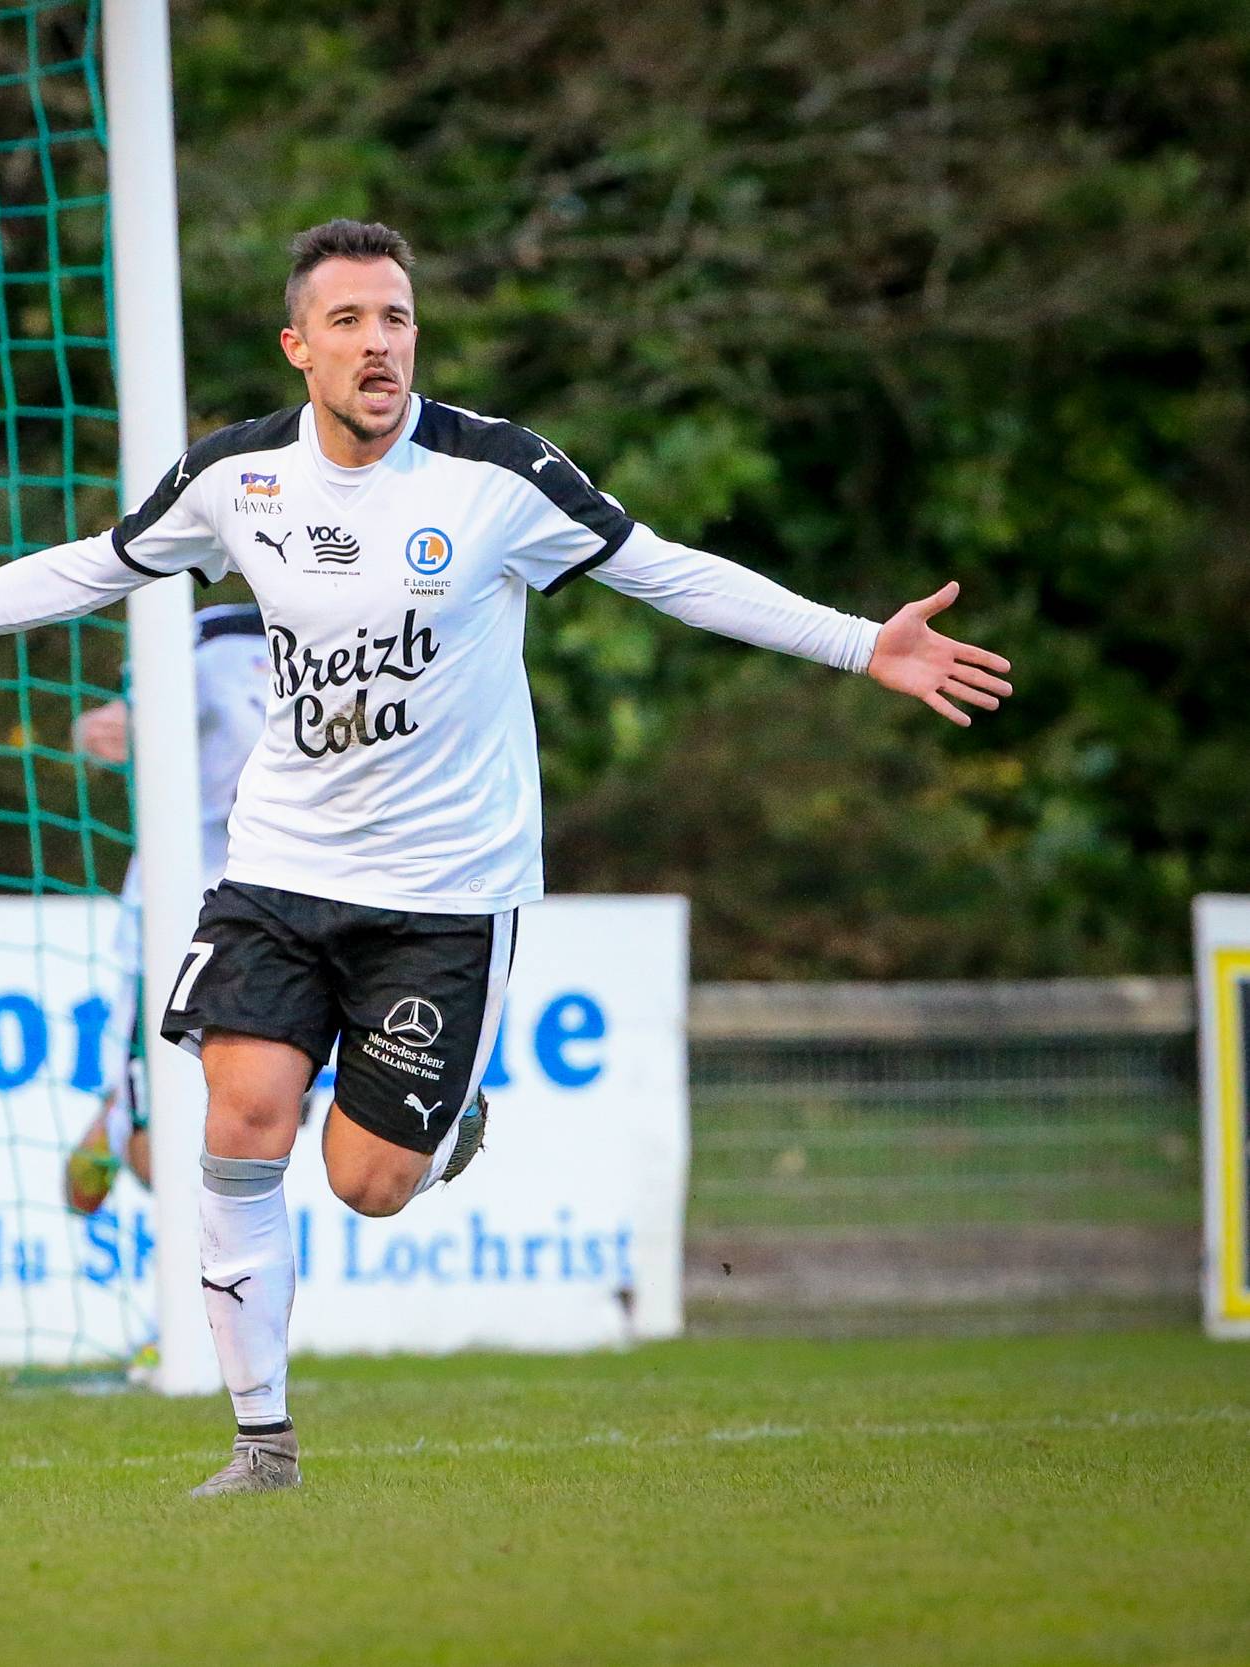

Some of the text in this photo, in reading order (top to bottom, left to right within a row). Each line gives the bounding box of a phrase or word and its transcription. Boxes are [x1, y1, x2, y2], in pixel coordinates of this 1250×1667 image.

[234, 496, 284, 514] VANNES
[306, 525, 346, 543] VOC
[403, 578, 452, 588] E.Leclerc
[409, 588, 445, 596] VANNES
[268, 608, 440, 699] Breizh
[293, 688, 419, 759] Cola
[169, 941, 215, 1011] 7
[368, 1031, 446, 1069] Mercedes-Benz
[343, 1206, 632, 1290] Lochrist
